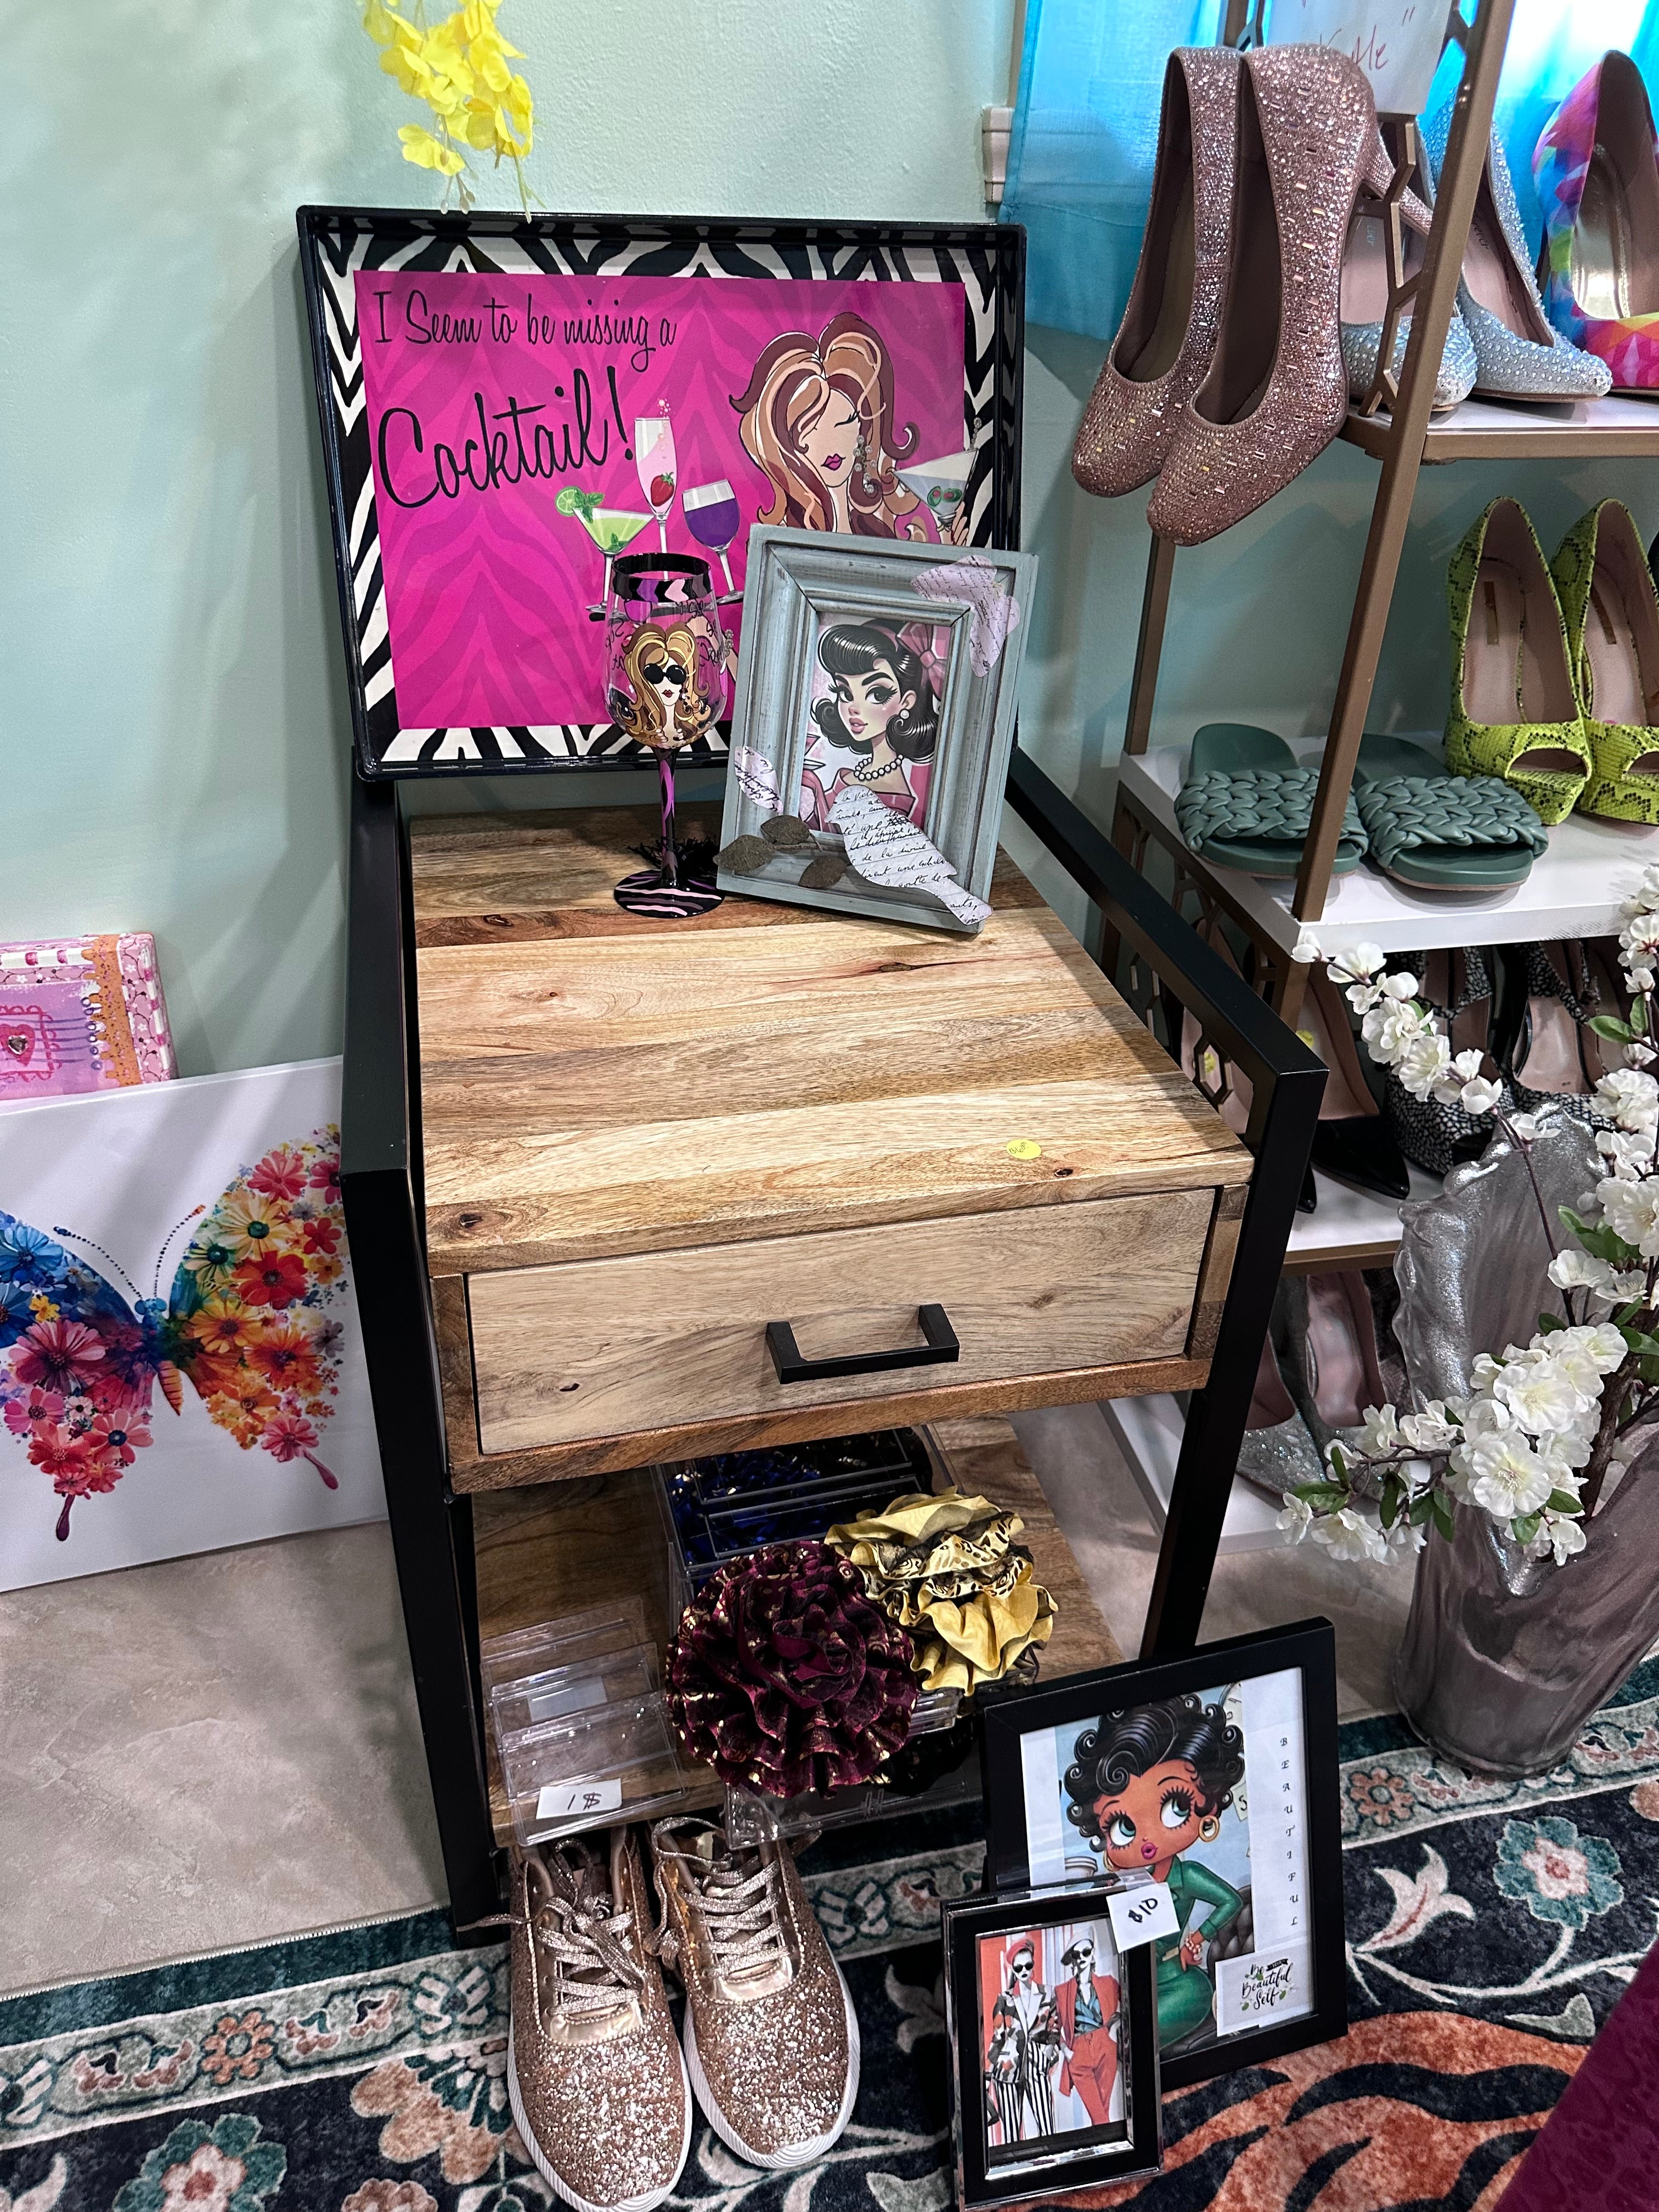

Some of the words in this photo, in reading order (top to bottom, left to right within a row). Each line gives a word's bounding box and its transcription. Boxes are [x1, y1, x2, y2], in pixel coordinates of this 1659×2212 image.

[373, 291, 393, 343] I
[405, 289, 483, 345] Seem
[483, 297, 518, 344] to
[527, 293, 556, 345] be
[563, 299, 656, 373] missing
[659, 319, 678, 347] a
[378, 365, 634, 508] Cocktail!
[1280, 1737, 1299, 1926] BEAUTIFUL
[1128, 1898, 1158, 1923] $10
[1241, 1962, 1294, 1999] Beautiful
[1254, 1987, 1279, 2010] Self
